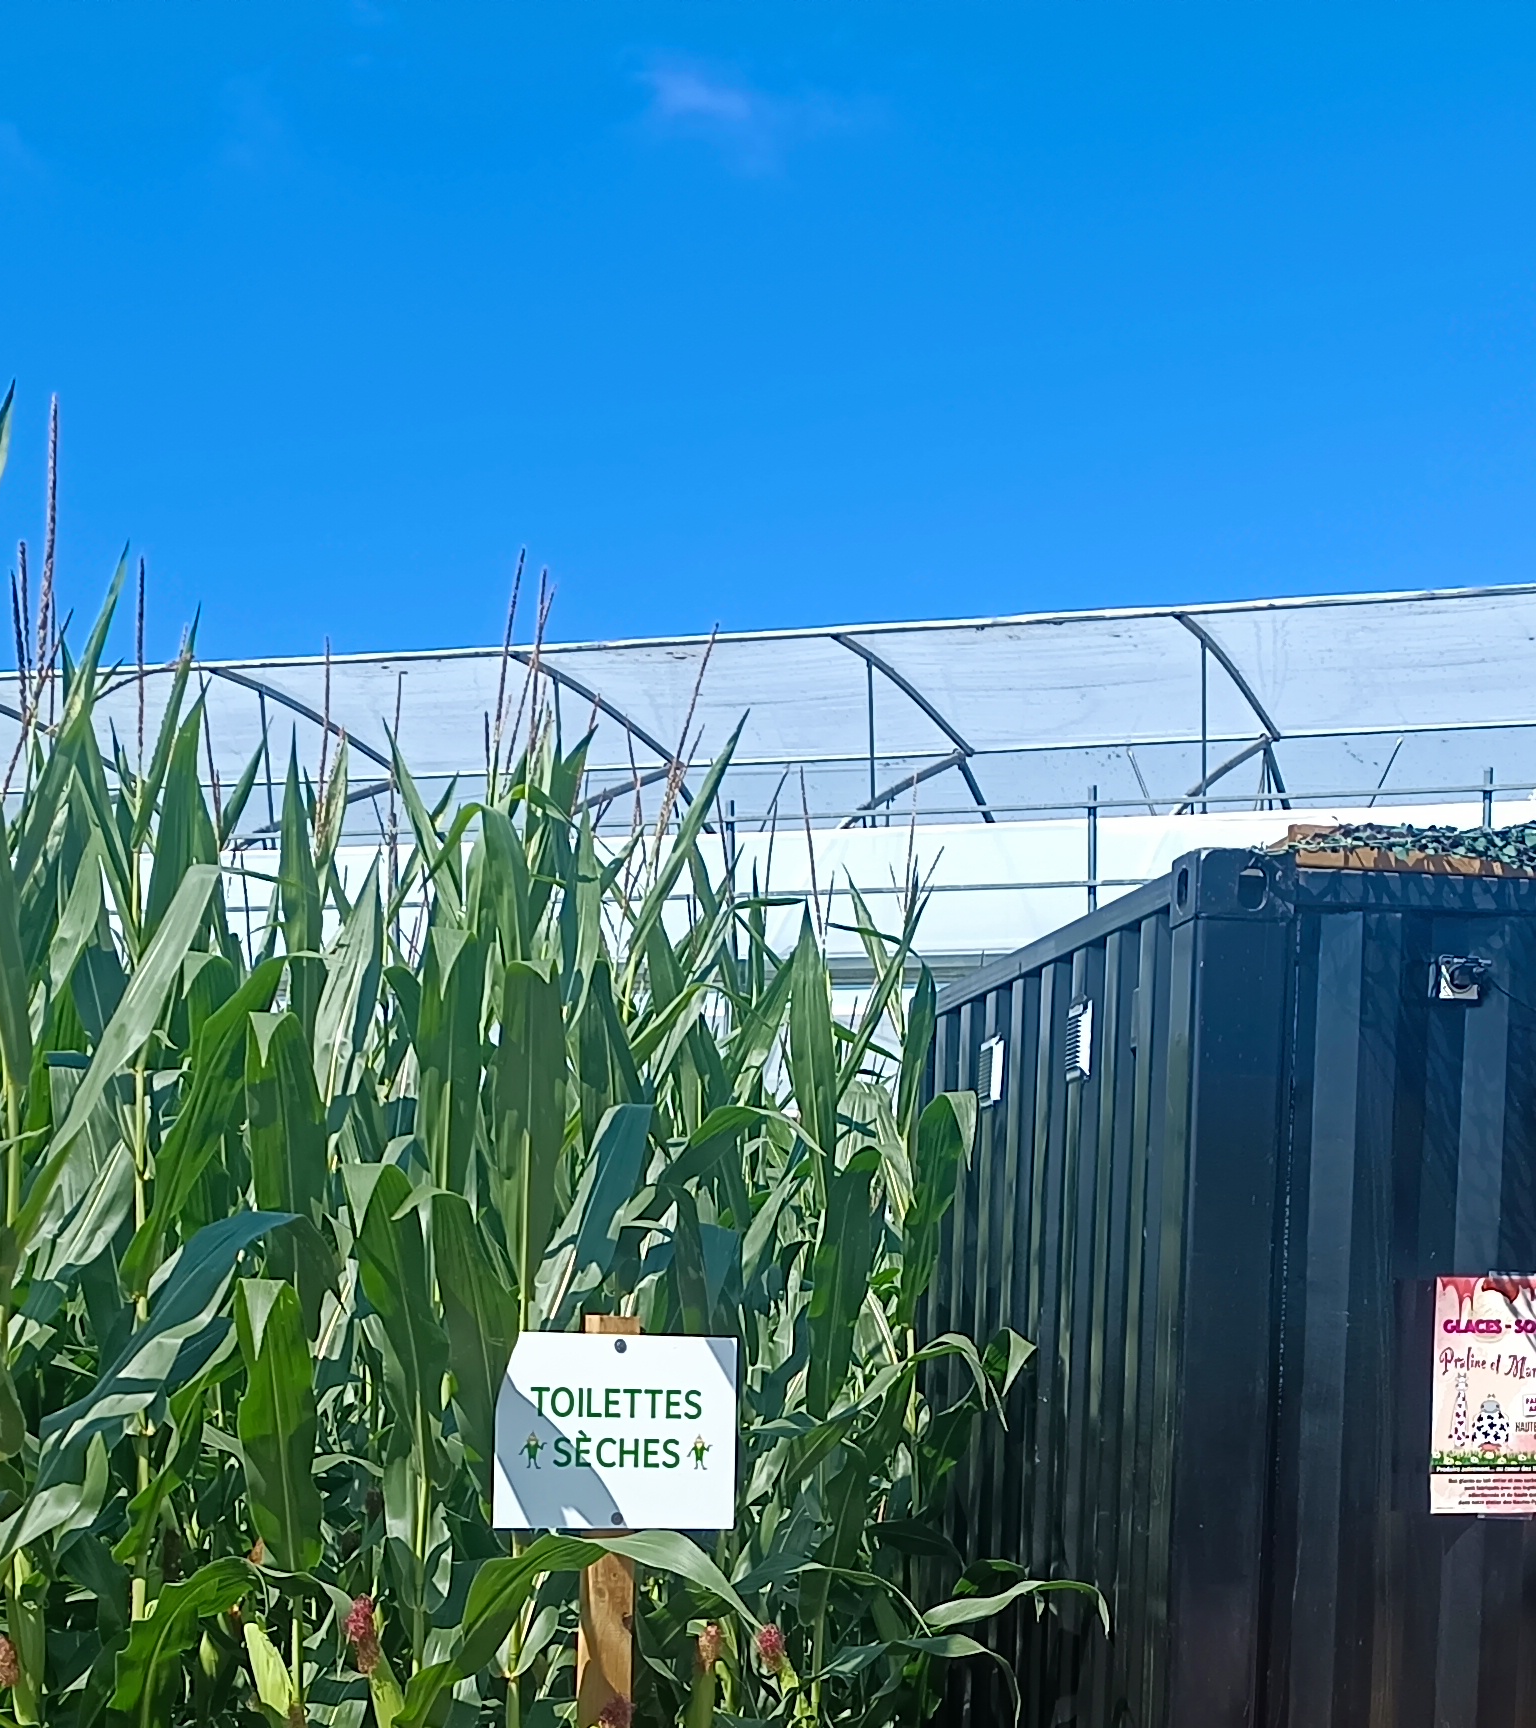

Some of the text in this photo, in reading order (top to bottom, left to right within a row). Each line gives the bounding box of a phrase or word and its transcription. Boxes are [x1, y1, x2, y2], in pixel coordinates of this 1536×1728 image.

[1442, 1318, 1502, 1334] GLACES
[1438, 1346, 1486, 1376] Praline
[1490, 1354, 1501, 1374] et
[530, 1386, 702, 1419] TOILETTES
[553, 1430, 680, 1468] SÈCHES
